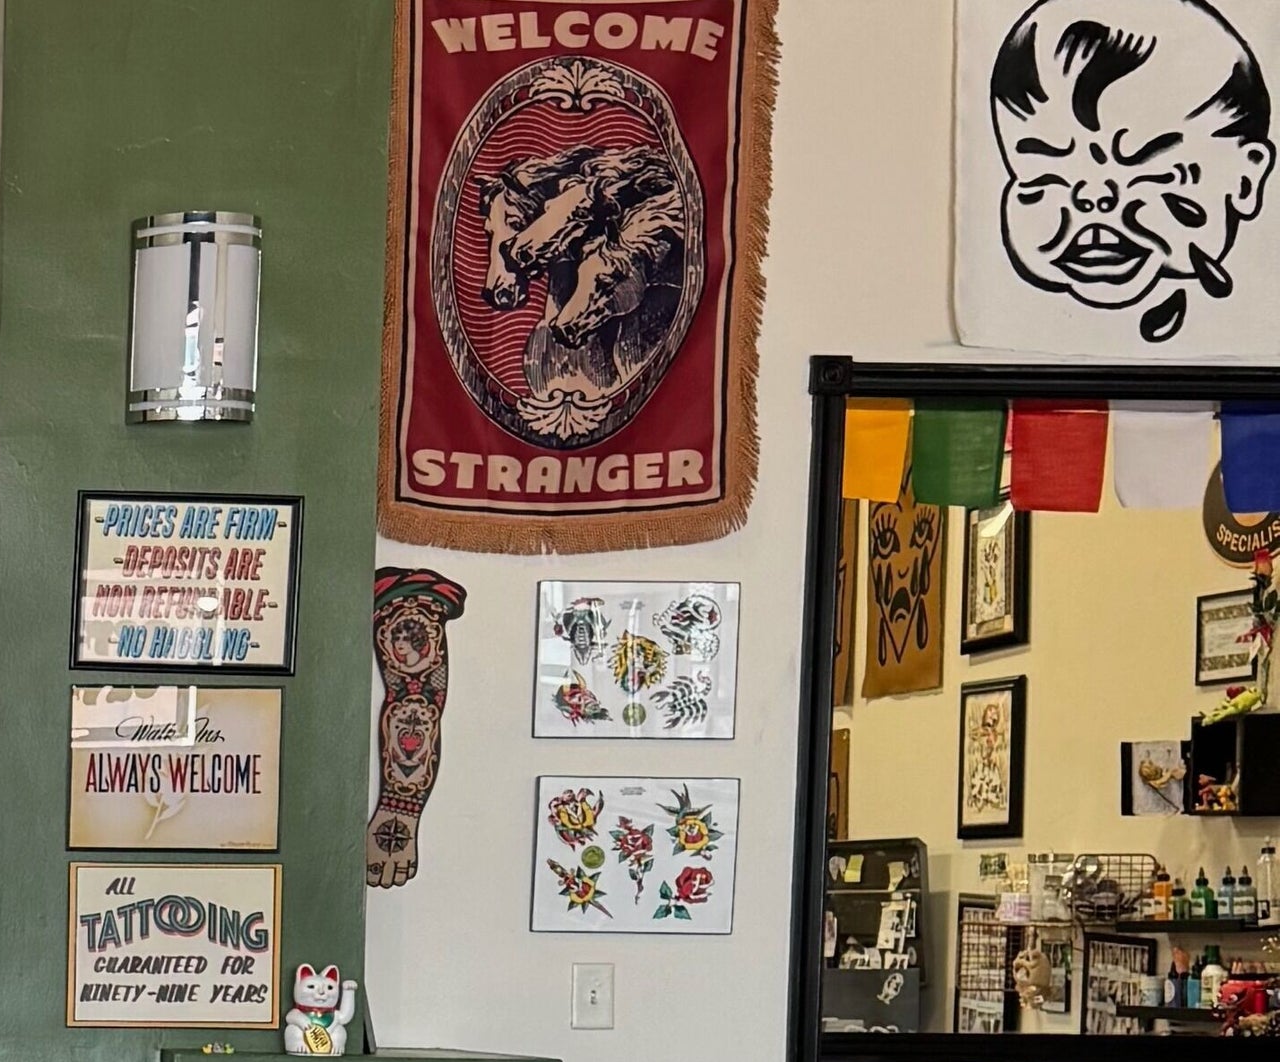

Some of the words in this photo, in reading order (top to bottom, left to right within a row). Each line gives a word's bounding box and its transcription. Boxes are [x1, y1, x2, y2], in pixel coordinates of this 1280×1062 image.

[431, 10, 725, 61] WELCOME
[412, 449, 704, 494] STRANGER
[179, 506, 222, 539] ARE
[224, 548, 266, 581] ARE
[93, 584, 137, 617] NON
[115, 716, 177, 742] Walk
[85, 753, 162, 793] ALWAYS
[168, 753, 262, 794] WELCOME
[105, 877, 136, 895] ALL
[80, 895, 270, 953] TATTOOING
[94, 955, 208, 975] GUARANTEED
[221, 955, 256, 975] FOR
[80, 984, 200, 1004] NINETY-NINE
[209, 984, 268, 1004] YEARS
